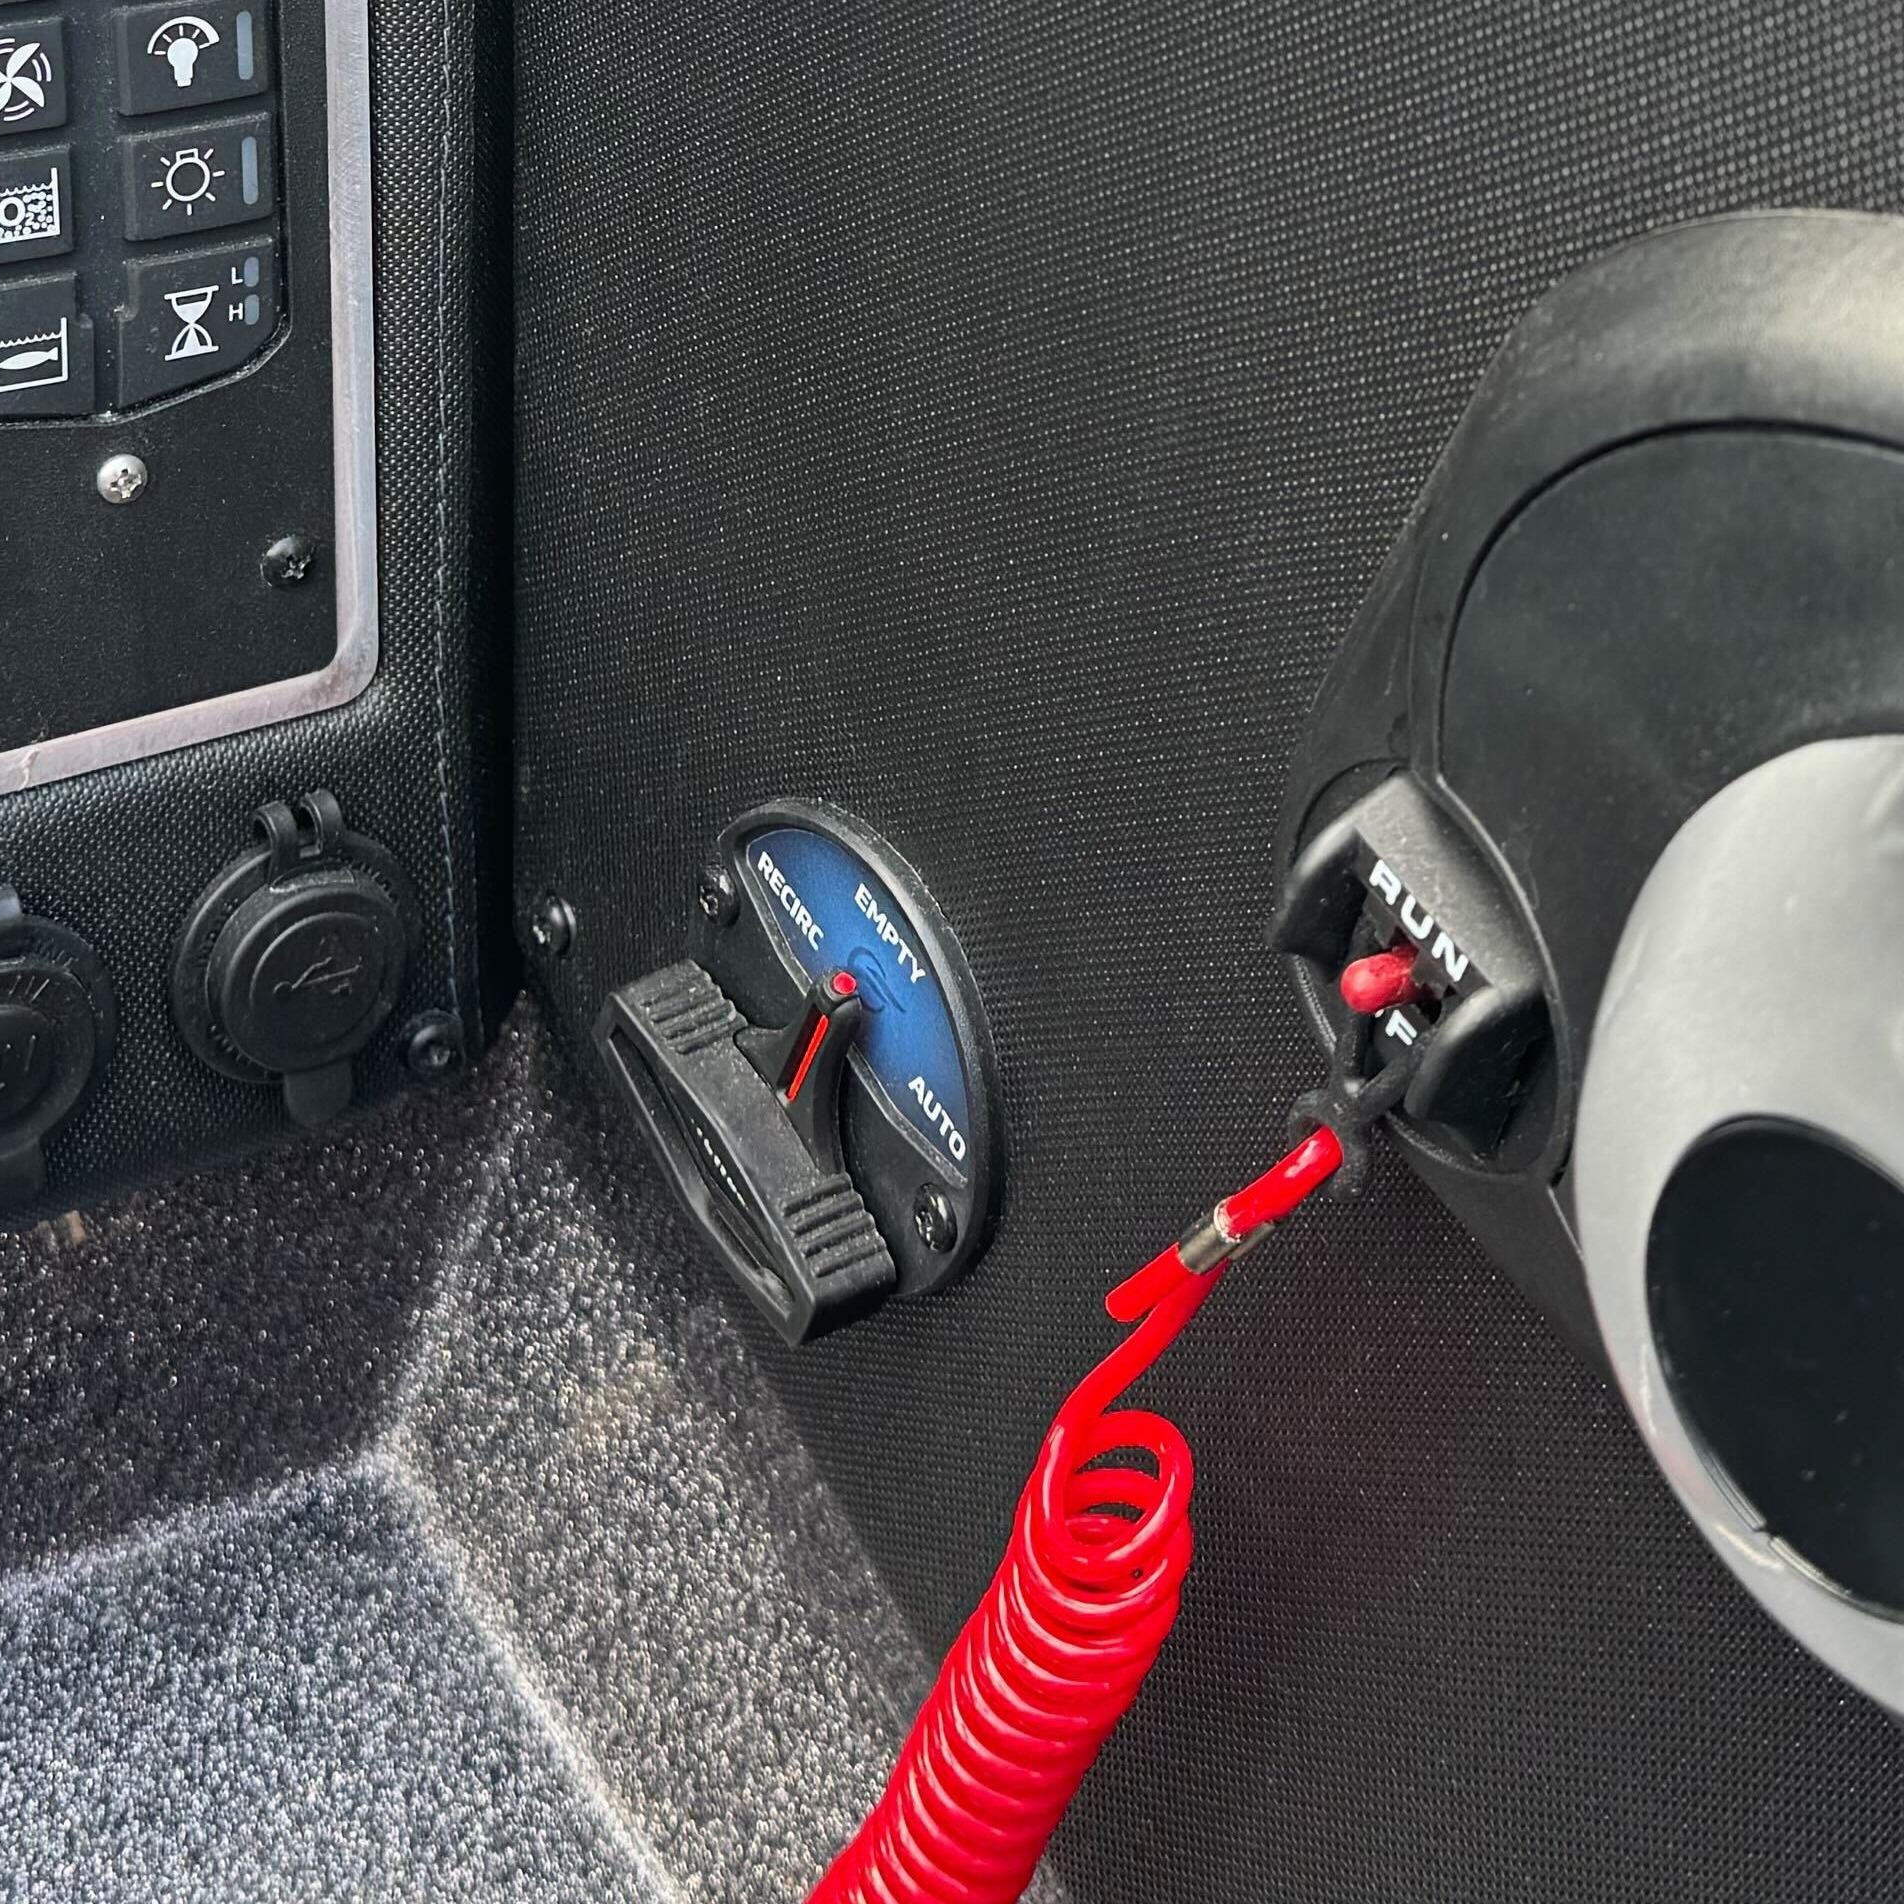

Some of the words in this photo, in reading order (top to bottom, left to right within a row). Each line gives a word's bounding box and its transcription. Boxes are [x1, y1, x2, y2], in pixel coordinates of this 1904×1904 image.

[228, 303, 244, 322] H
[231, 267, 244, 285] L
[757, 851, 825, 951] RECIRC
[854, 883, 926, 984] EMPTY
[1369, 859, 1470, 982] RUN
[908, 1075, 966, 1162] AUTO
